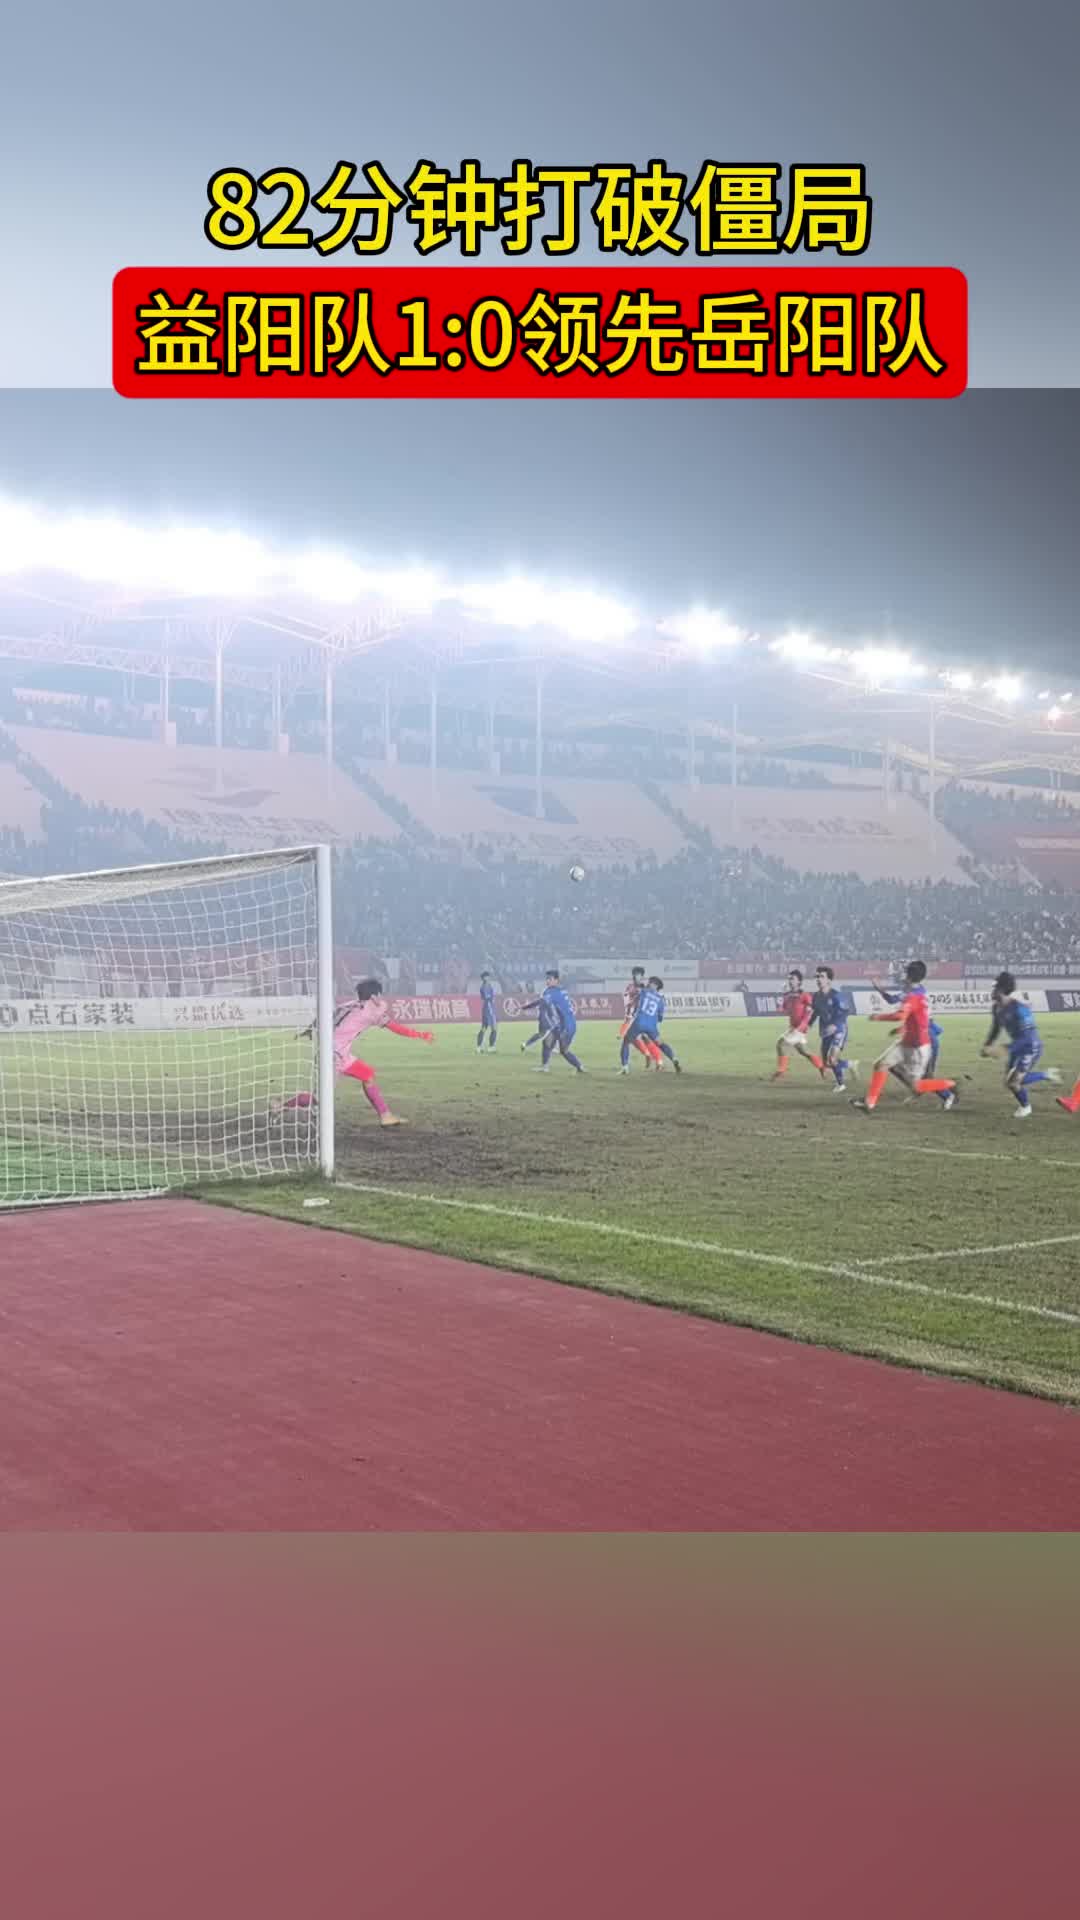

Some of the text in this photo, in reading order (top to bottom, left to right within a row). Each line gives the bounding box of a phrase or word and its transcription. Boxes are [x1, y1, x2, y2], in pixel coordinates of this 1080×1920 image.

[28, 1002, 136, 1027] 点石家装
[391, 998, 471, 1019] 永瑞体育
[642, 997, 658, 1016] 13
